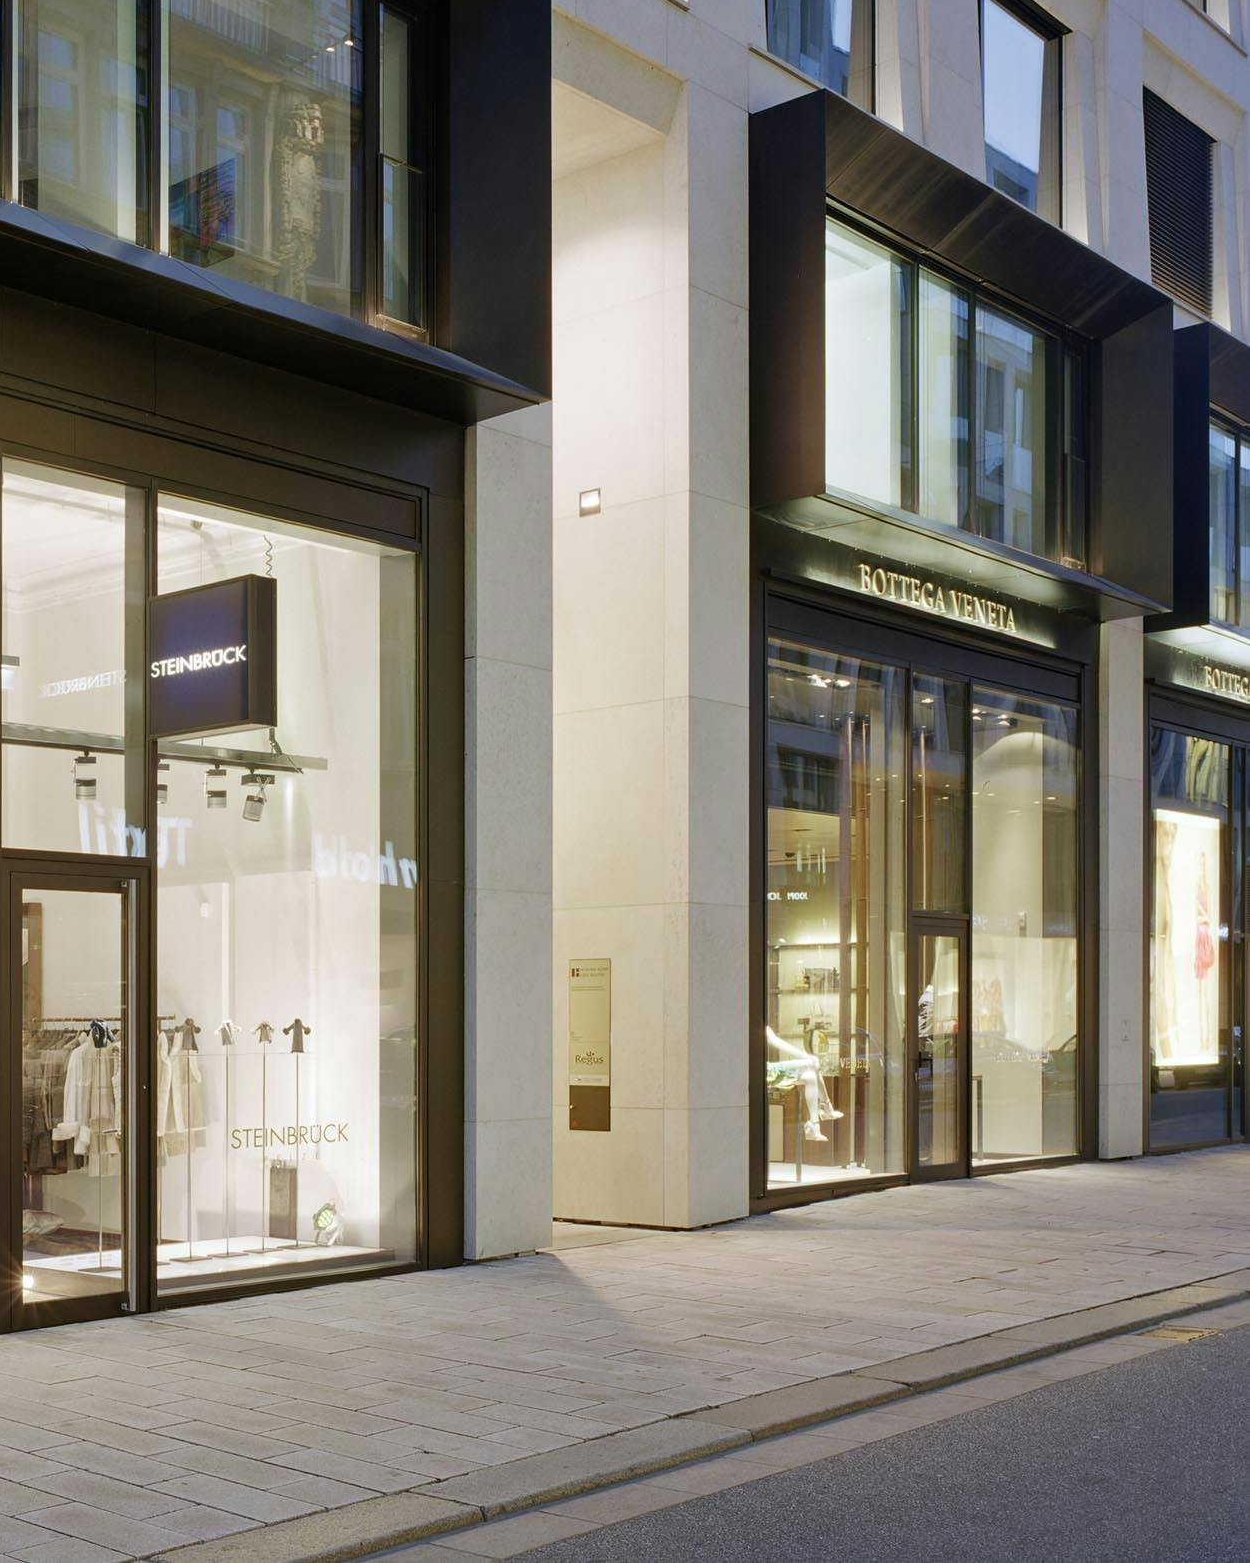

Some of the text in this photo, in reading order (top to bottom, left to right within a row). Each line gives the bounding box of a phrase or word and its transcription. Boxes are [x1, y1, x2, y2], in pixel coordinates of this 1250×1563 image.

[858, 563, 1016, 633] BOTTEGA VENETA
[575, 1054, 604, 1065] Regus
